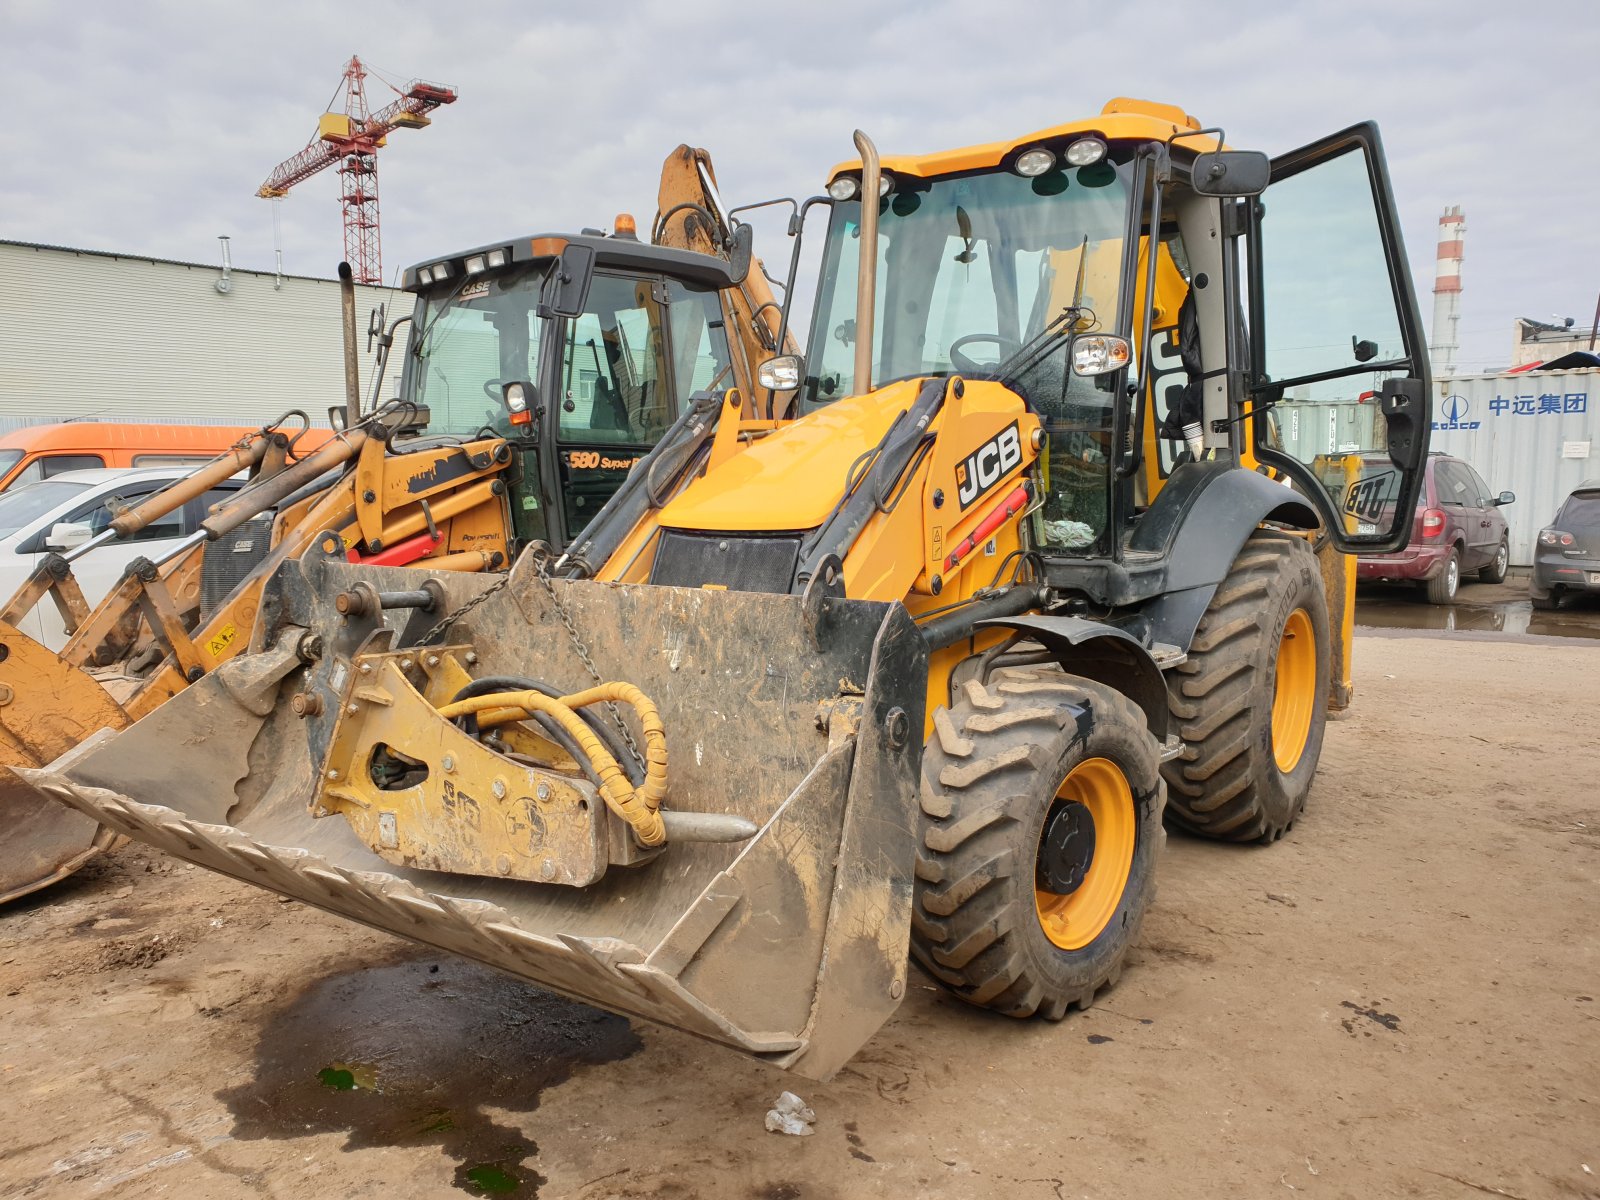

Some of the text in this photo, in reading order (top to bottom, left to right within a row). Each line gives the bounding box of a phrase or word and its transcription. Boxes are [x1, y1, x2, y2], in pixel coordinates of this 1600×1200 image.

[461, 280, 491, 295] CASE
[1489, 393, 1587, 416] 中远集团
[570, 452, 600, 468] 580
[601, 458, 631, 470] Super
[960, 426, 1020, 504] JCB
